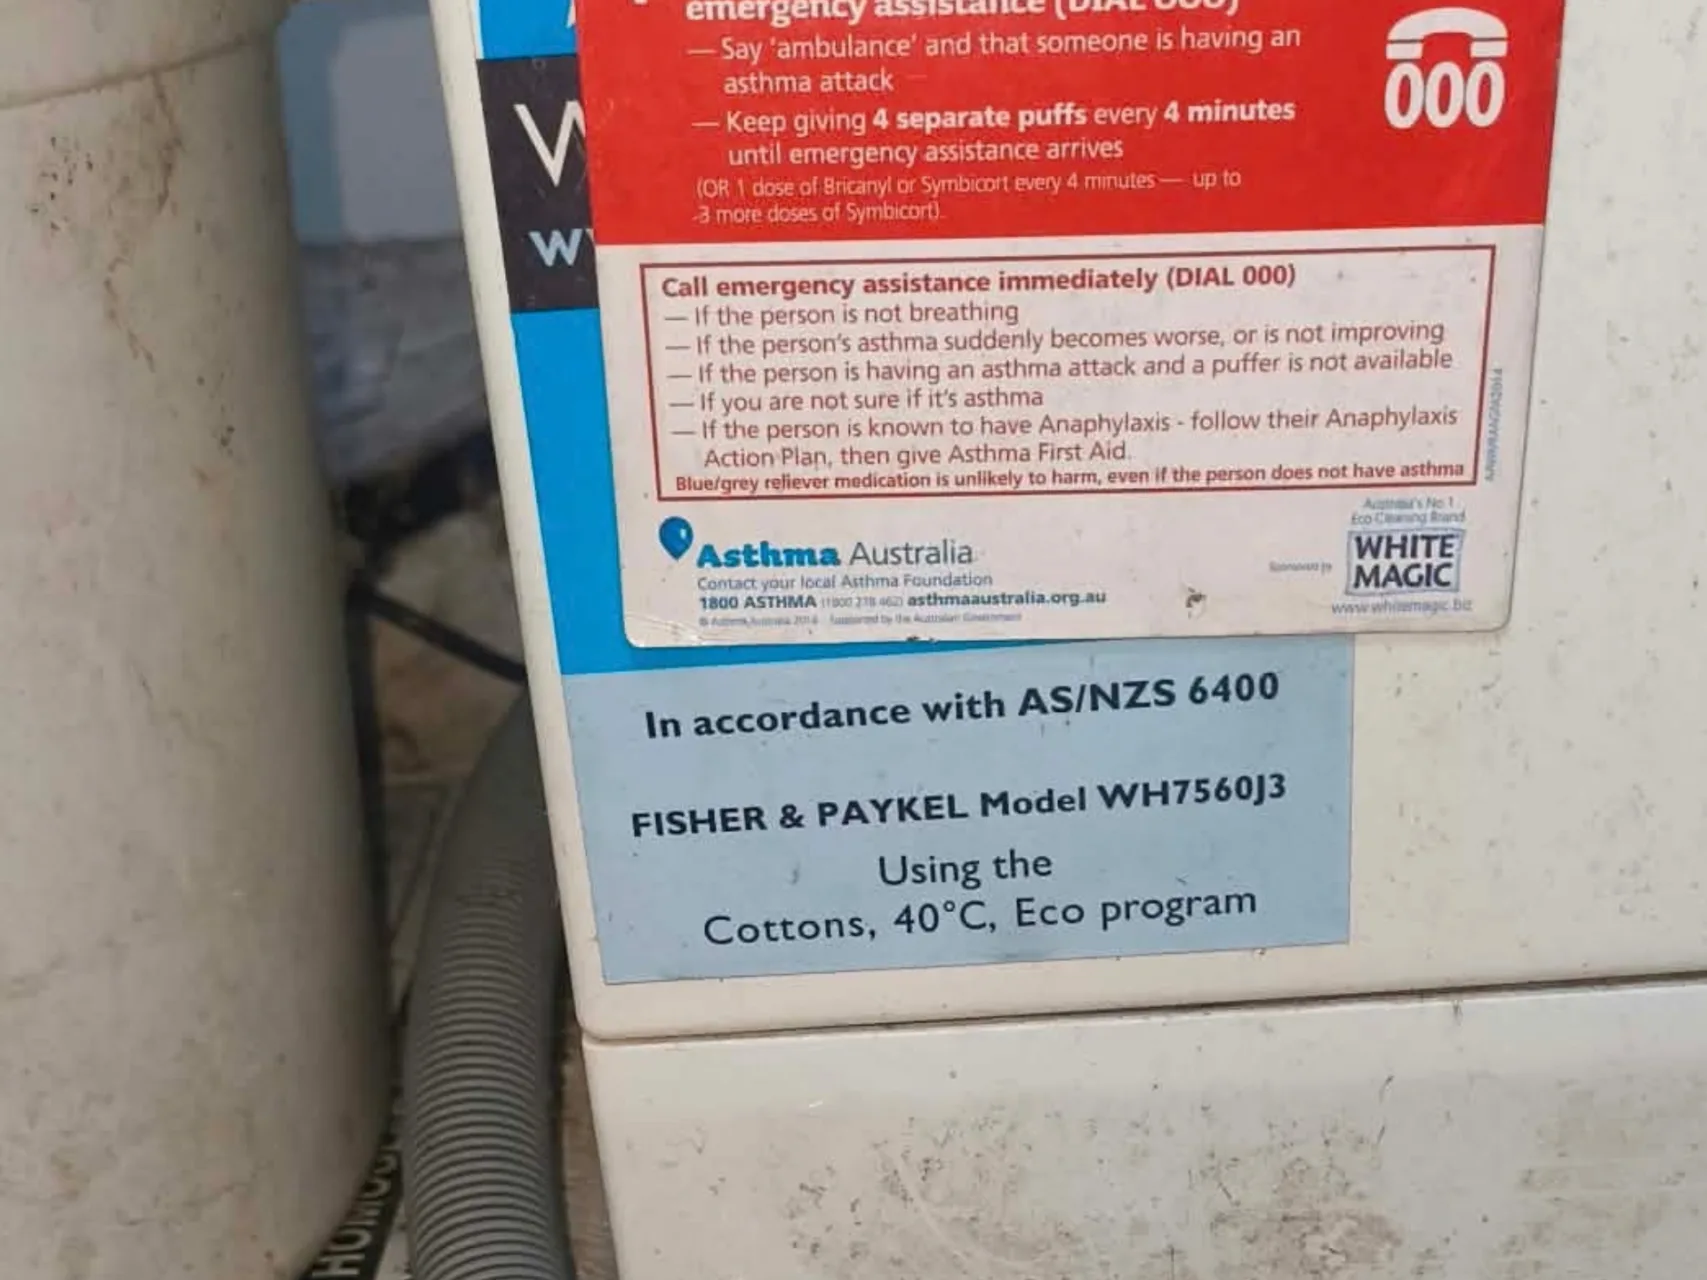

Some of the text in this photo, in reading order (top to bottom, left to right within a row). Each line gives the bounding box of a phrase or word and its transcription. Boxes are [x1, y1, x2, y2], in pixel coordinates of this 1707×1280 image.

[721, 35, 763, 66] Say
[925, 30, 972, 57] and
[978, 30, 1031, 55] that
[1036, 32, 1149, 54] someone
[1155, 26, 1174, 50] is
[1180, 23, 1264, 54] having
[1270, 27, 1301, 47] an
[723, 65, 895, 95] asthma attack
[1383, 60, 1507, 129] 000
[726, 97, 1296, 138] Keep giving 4 separate puffs every 4 minutes
[728, 135, 1124, 170] until emergency assistance arrives
[696, 171, 1156, 200] (OR dose of Bricanyl or Symbicort every minutes
[1192, 168, 1242, 191] up to
[715, 200, 841, 224] more doses of
[661, 262, 1296, 301] Call emergency assistance immediately (DIAL 000)
[694, 299, 1020, 330] If the person is not breathing
[696, 319, 1445, 360] If the person's asthma suddenly becomes worse, or is not improving
[698, 346, 1454, 388] If the person is having an asthma attack and a puffer is not available
[700, 390, 716, 411] If
[720, 395, 763, 417] you
[768, 394, 805, 411] are
[810, 390, 849, 411] not
[853, 392, 901, 410] sure
[906, 386, 923, 409] if
[963, 384, 1044, 408] asthma
[702, 404, 1458, 444] If the person is known to have Anaphylaxis follow their Anaphylaxis
[703, 441, 1085, 471] Action Plan, then give Asthma First
[675, 459, 1464, 495] Blue/grey reliever medication is unlikely to harm, even if the person does not have asthma
[696, 537, 974, 568] Asthma Australia
[1354, 533, 1456, 560] WHITE
[697, 570, 994, 593] Contact your local Asthma Foundation
[1353, 562, 1452, 589] MAGIC
[699, 589, 1107, 611] 1800 ASTHMA asthmaaustralia.org.au
[645, 670, 1279, 739] In accordance with AS/NZS 6400
[631, 772, 1286, 837] FISHER & PAYKEL Model WH7560J3
[878, 847, 1053, 891] Using the
[703, 891, 1257, 945] Cottons, 40°C, Eco program
